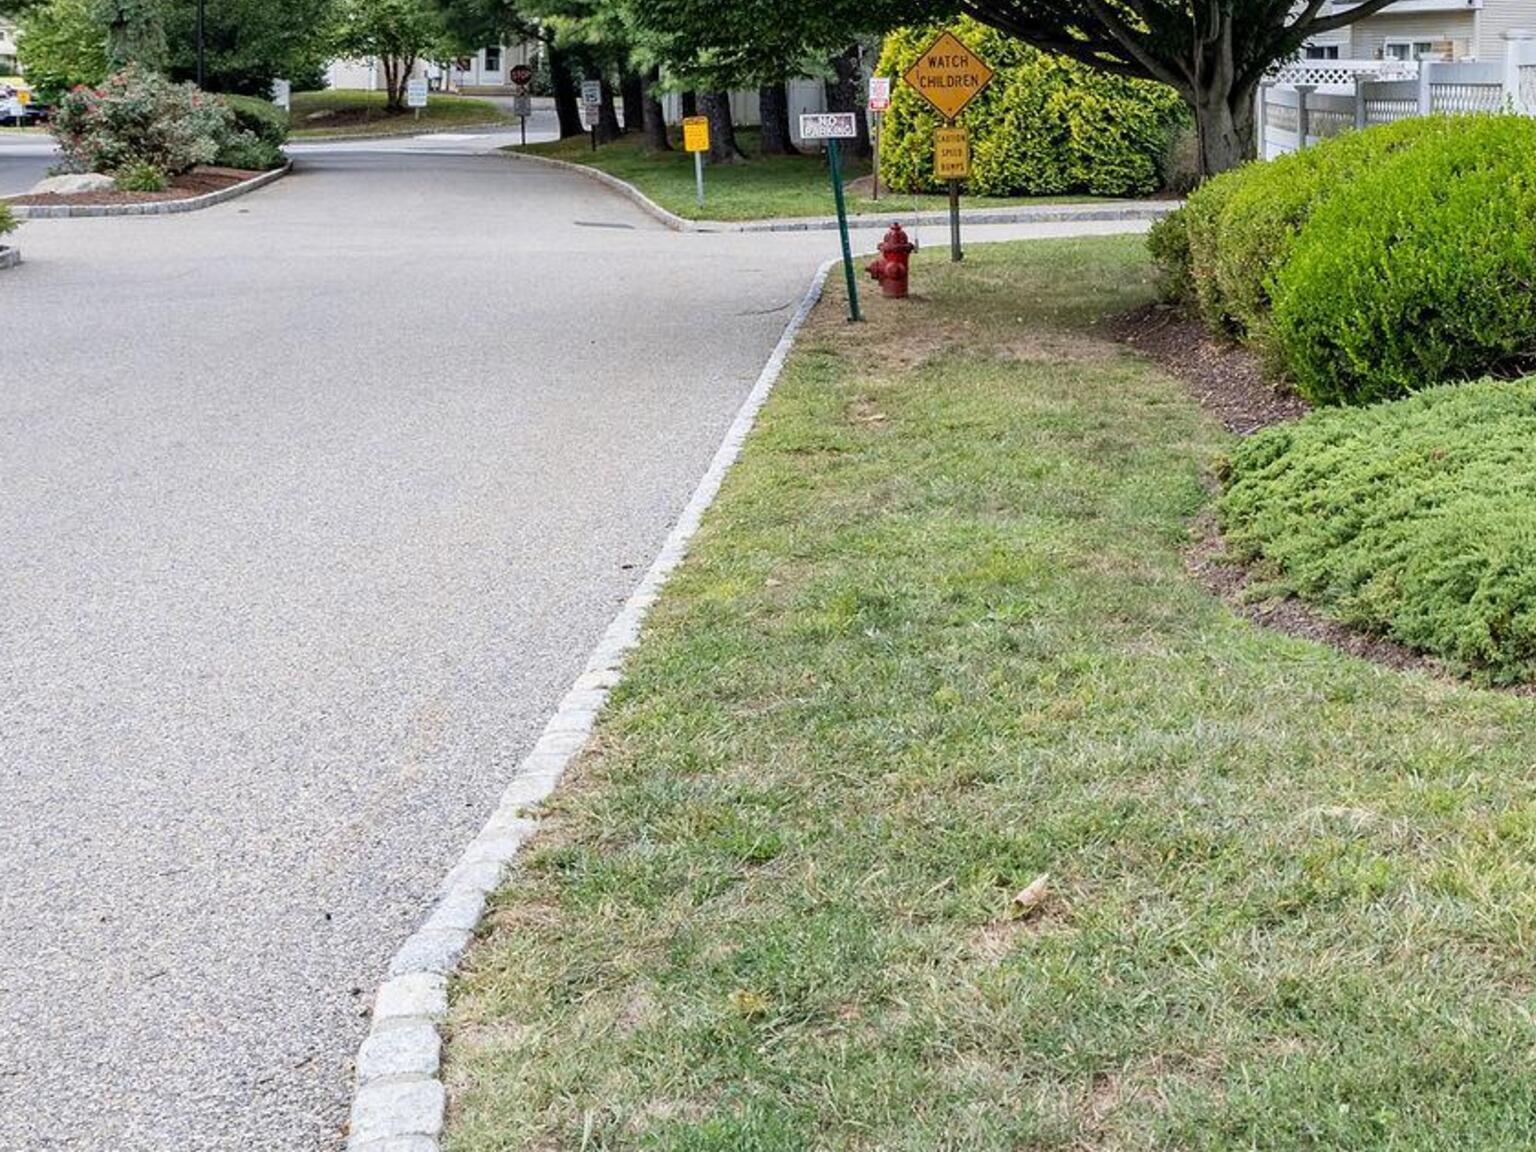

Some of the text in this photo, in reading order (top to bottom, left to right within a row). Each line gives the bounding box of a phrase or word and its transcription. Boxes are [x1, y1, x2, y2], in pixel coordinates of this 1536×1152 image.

[928, 55, 969, 68] WATCH
[920, 74, 978, 88] CHILDREN
[819, 116, 837, 127] NO
